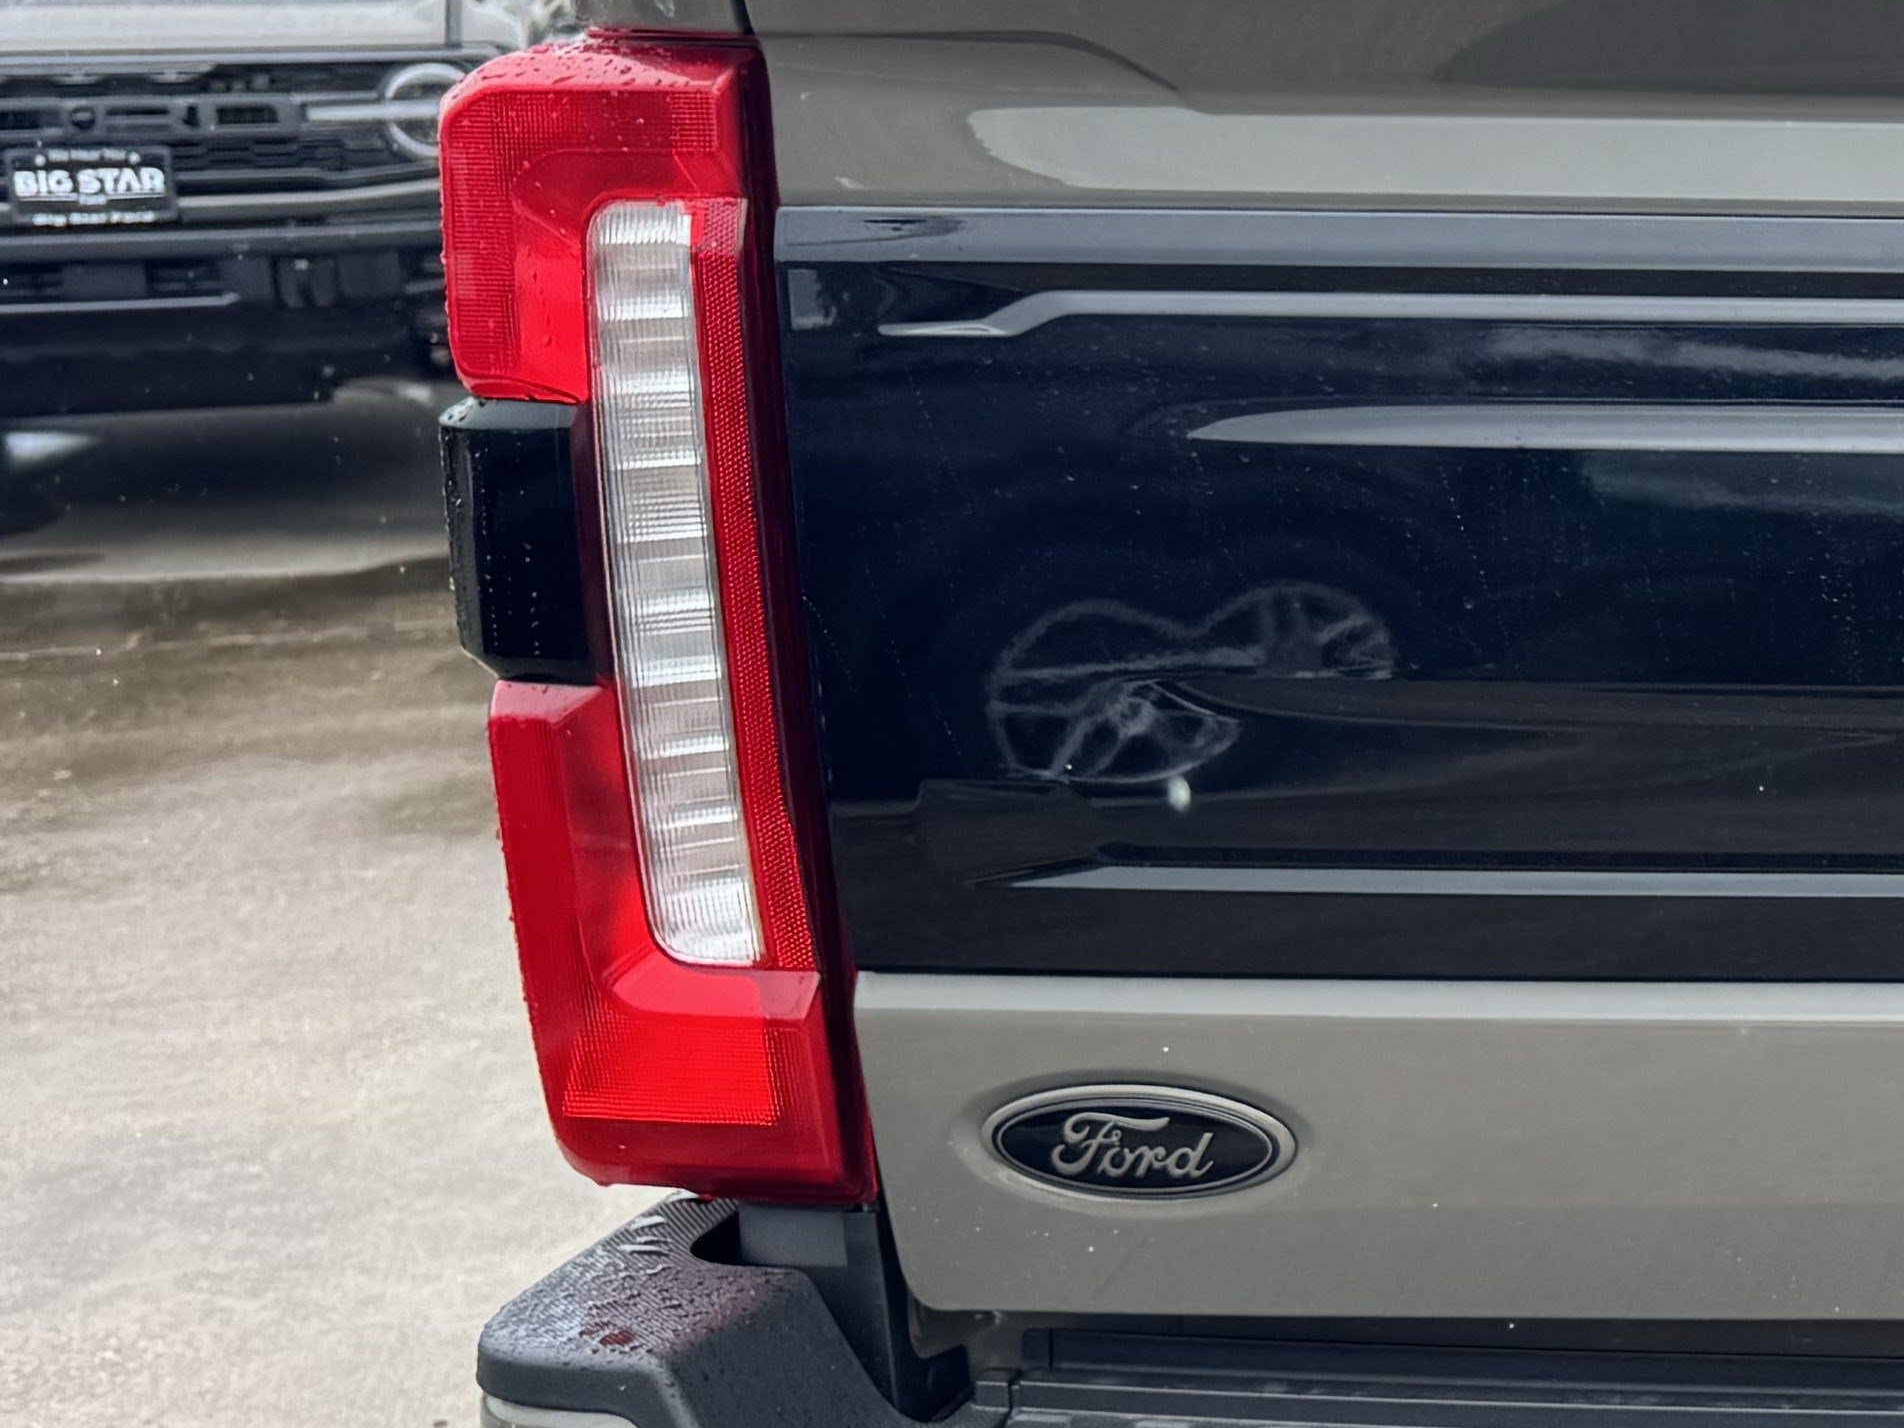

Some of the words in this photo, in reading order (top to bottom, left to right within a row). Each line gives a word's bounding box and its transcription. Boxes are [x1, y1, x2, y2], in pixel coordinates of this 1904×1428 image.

[13, 169, 74, 196] BIG
[77, 167, 166, 195] STAR
[1052, 1111, 1214, 1179] Ford
